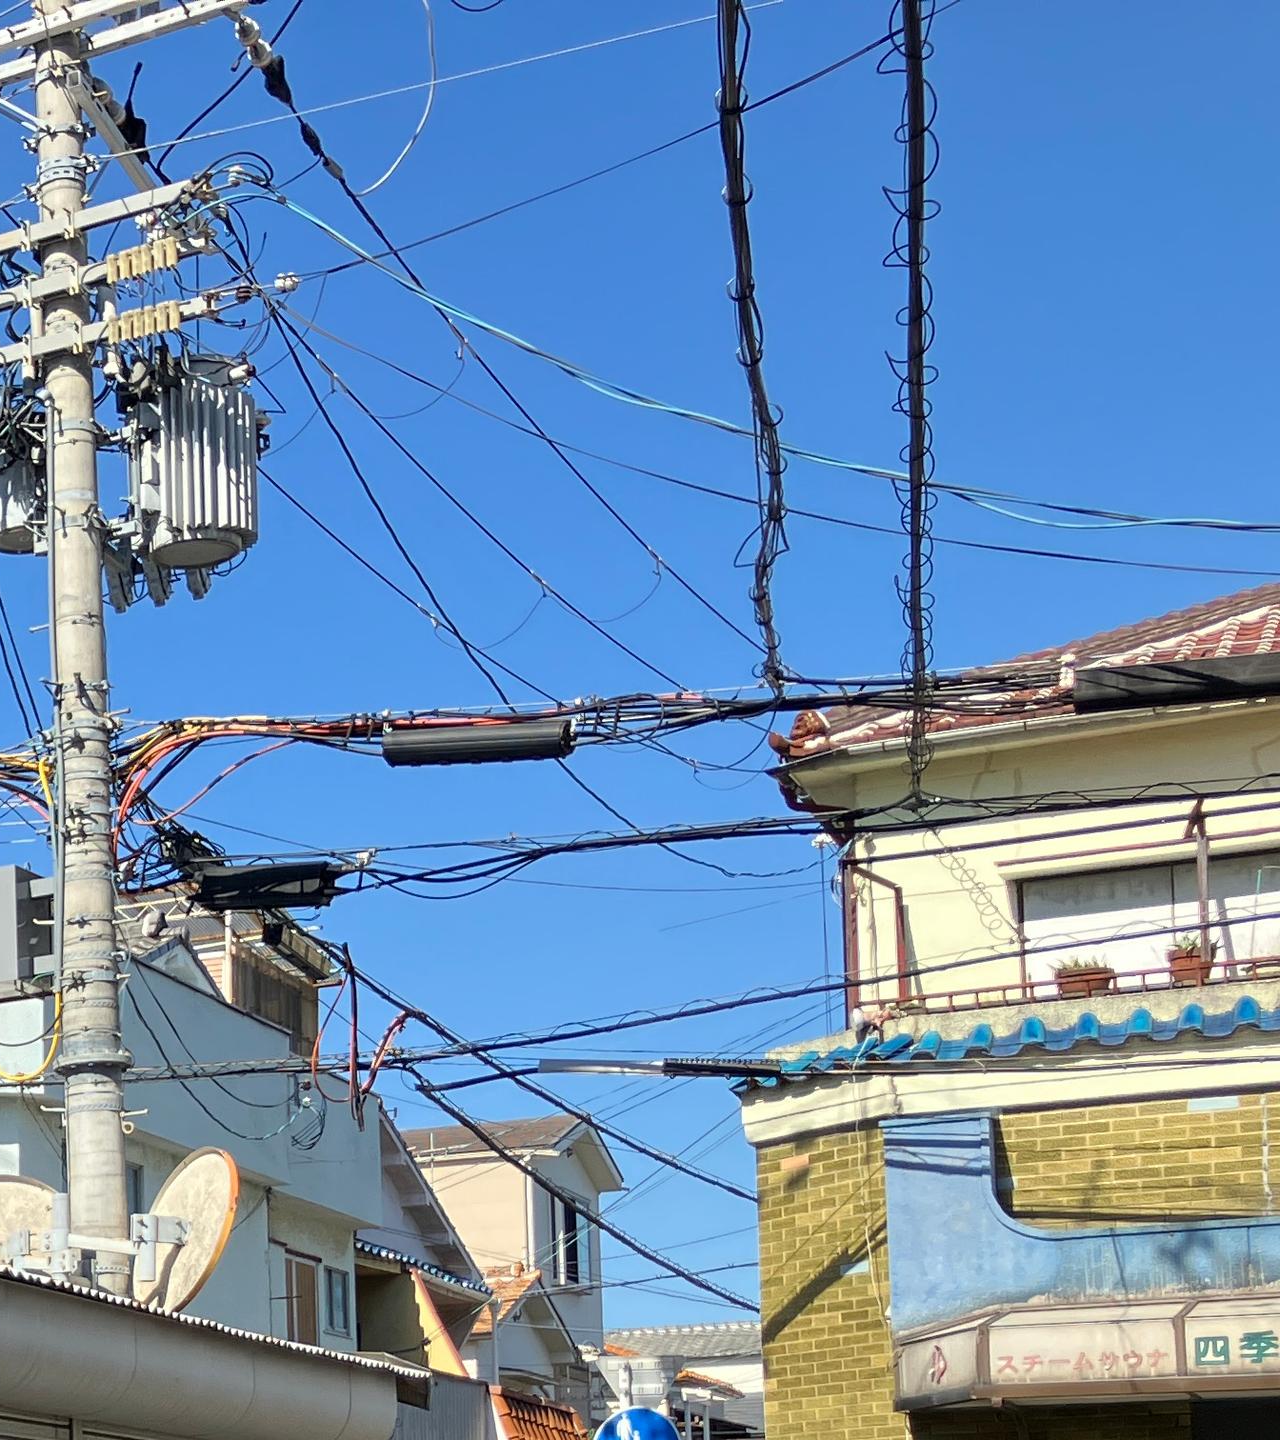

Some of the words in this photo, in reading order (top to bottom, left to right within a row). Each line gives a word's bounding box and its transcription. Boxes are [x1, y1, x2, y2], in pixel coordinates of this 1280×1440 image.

[997, 1349, 1168, 1375] スチームサウナ
[1195, 1330, 1279, 1366] 四季
